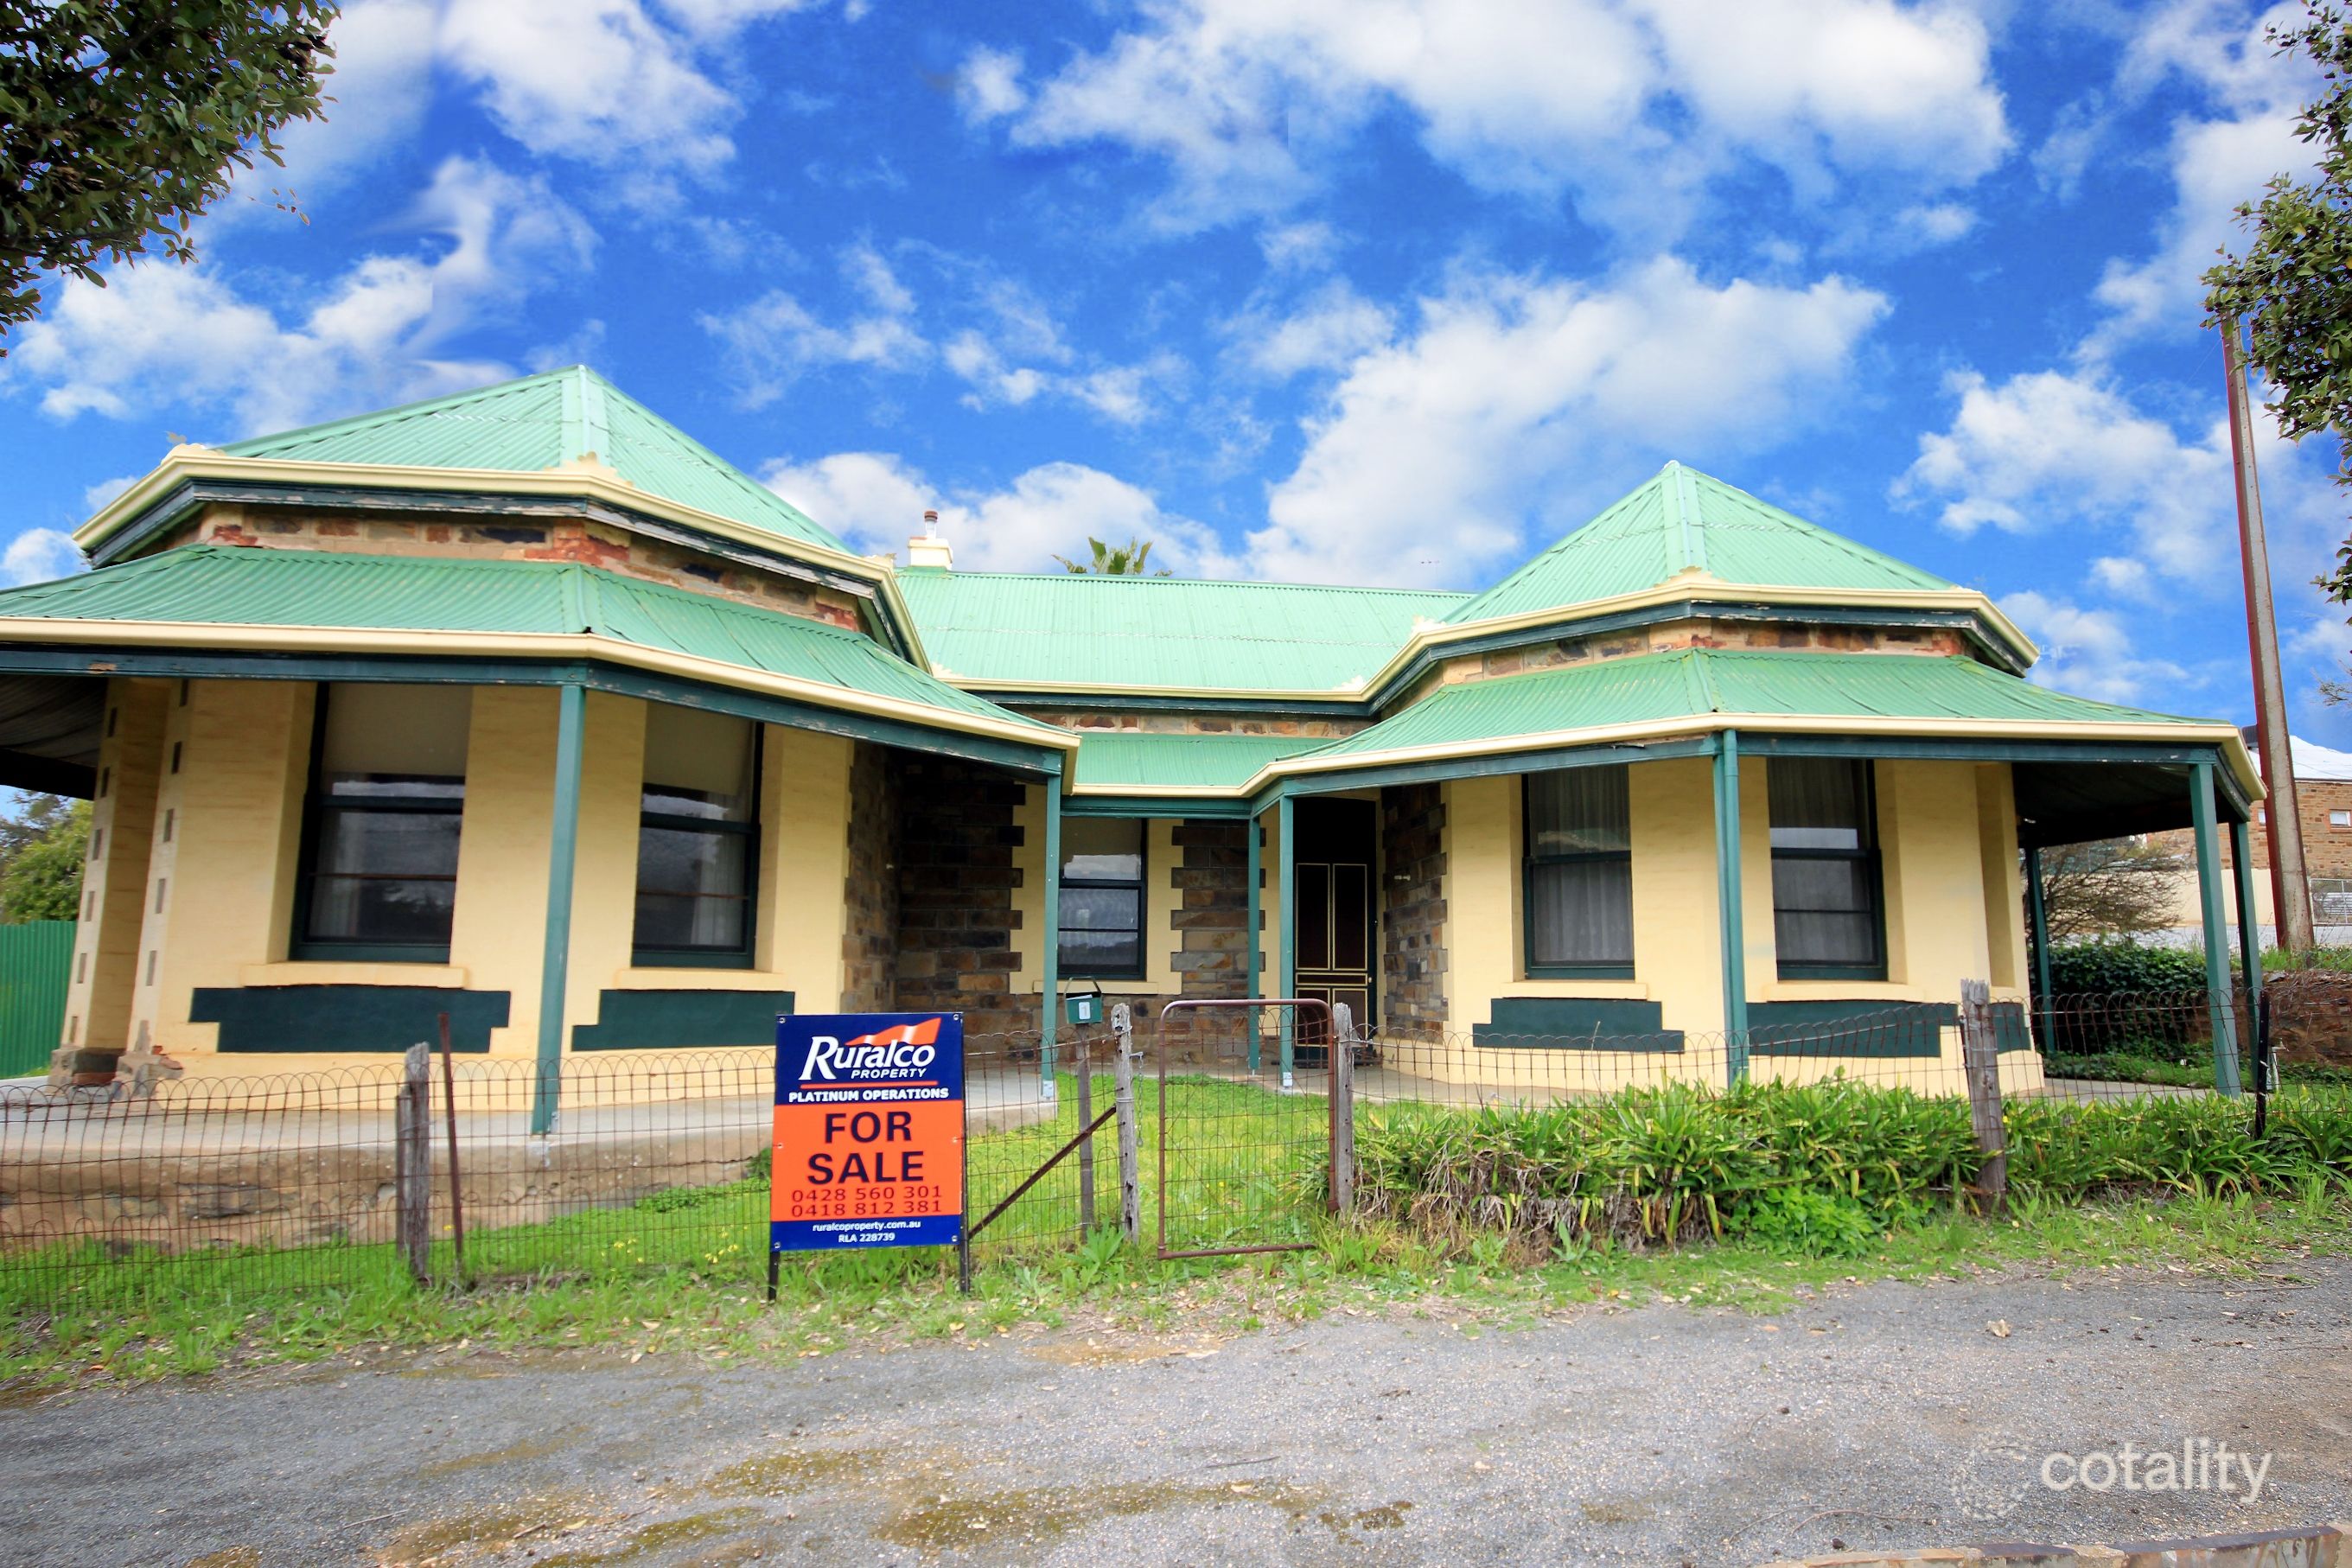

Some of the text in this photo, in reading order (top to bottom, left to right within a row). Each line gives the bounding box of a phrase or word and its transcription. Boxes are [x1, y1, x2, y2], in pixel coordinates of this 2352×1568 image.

[798, 1036, 935, 1080] Ruralco
[851, 1068, 927, 1080] PROPERTY
[788, 1087, 949, 1103] PLATINUM OPERATIONS
[825, 1111, 912, 1144] FOR
[807, 1151, 924, 1185] SALE
[792, 1185, 942, 1201] 0428 560 301
[792, 1200, 942, 1217] 0418 812 381
[813, 1221, 921, 1233] ruralcoproperty.com.au
[838, 1233, 896, 1243] RLA 228739
